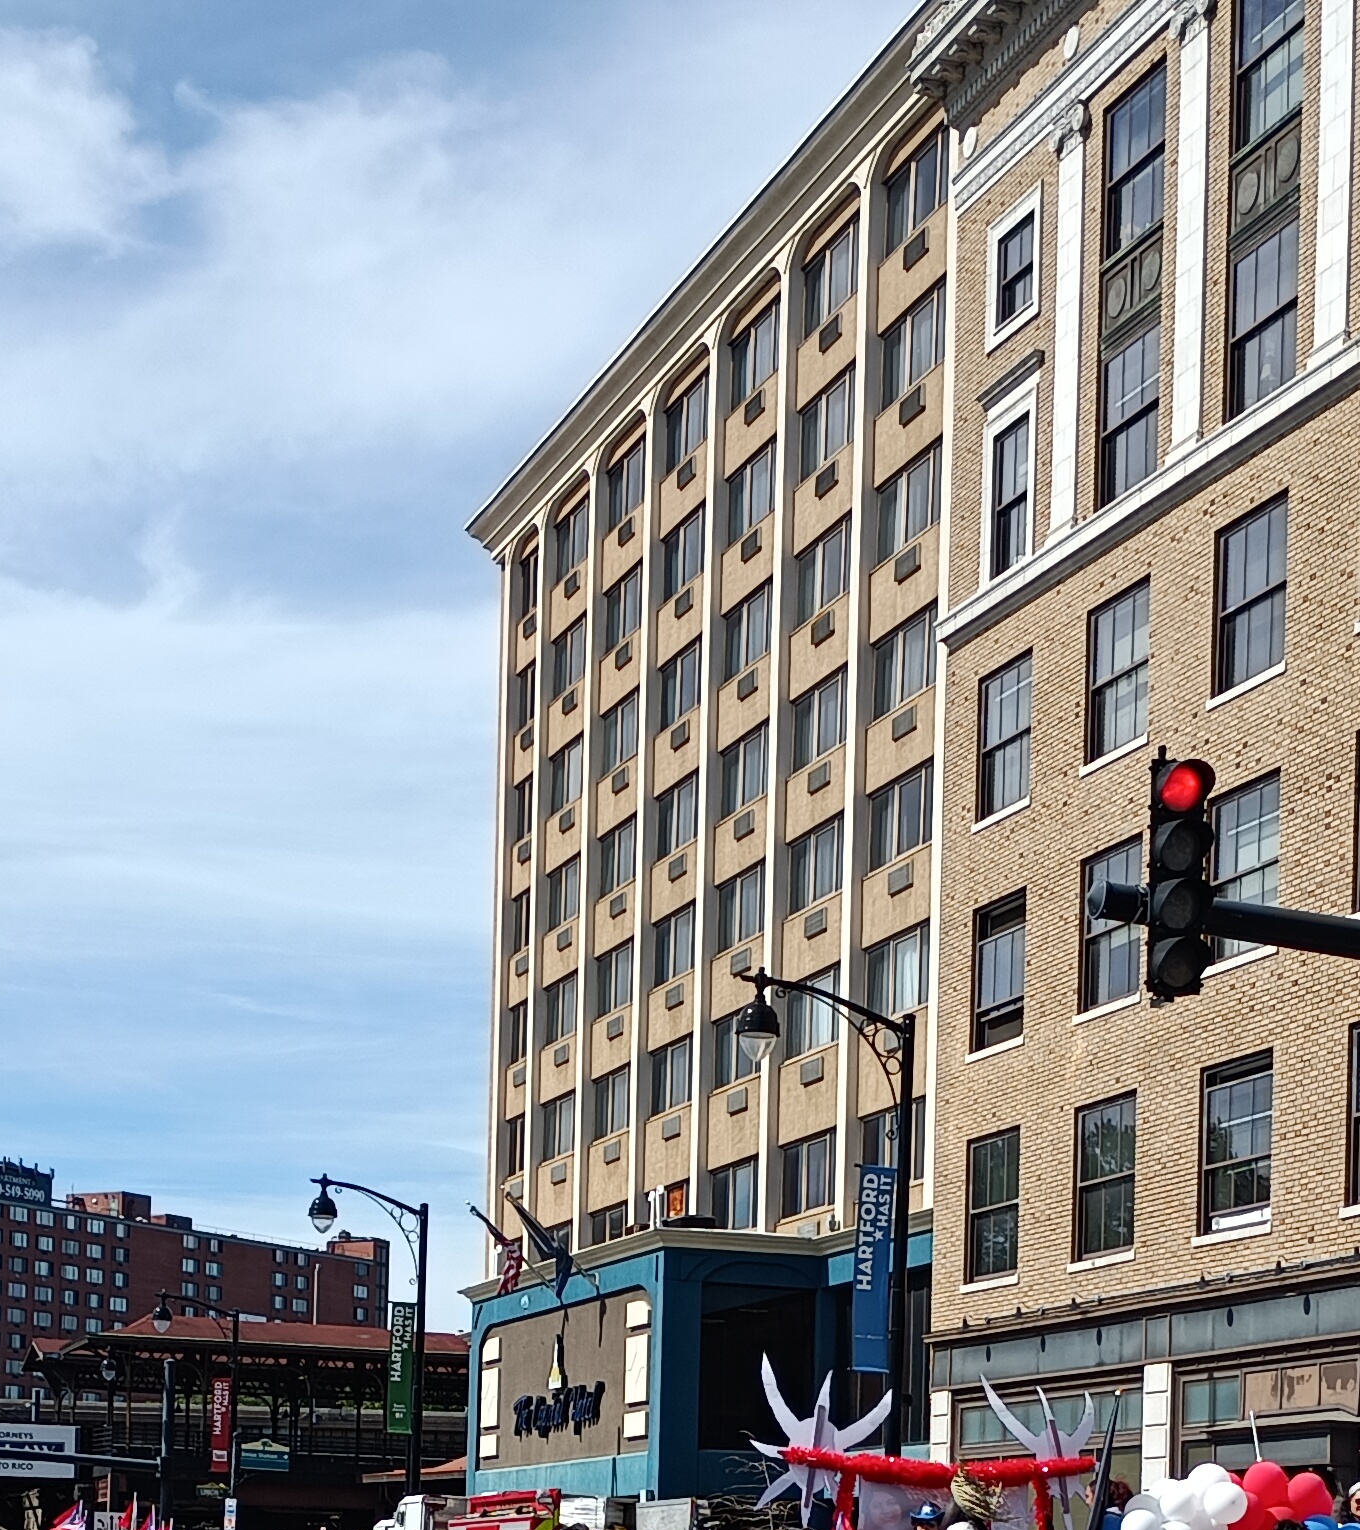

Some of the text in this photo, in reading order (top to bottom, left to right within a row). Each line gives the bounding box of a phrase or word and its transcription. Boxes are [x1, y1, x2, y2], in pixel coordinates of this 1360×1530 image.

[876, 1174, 892, 1227] HAS IT
[856, 1173, 879, 1290] HARTFORD
[390, 1306, 405, 1381] HARTFORD
[403, 1307, 414, 1340] HAS IT
[212, 1381, 223, 1435] HARTFORD
[11, 1462, 34, 1471] RICO
